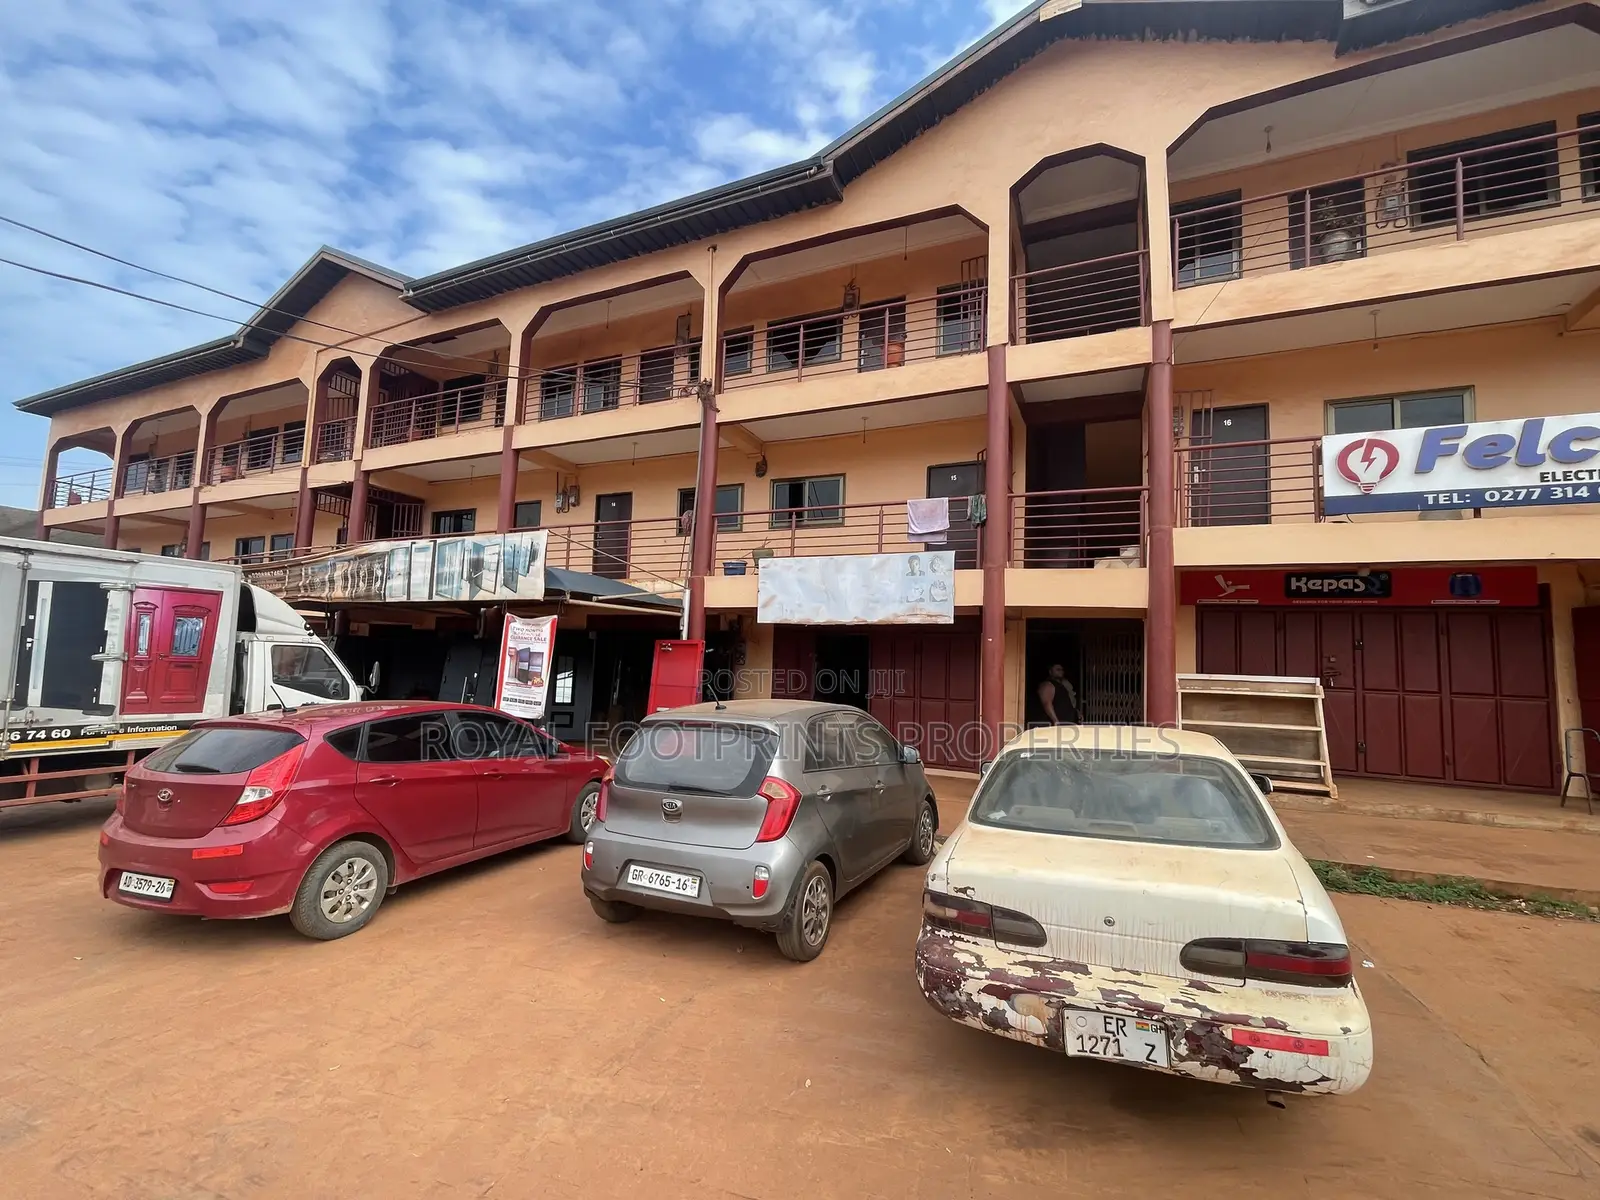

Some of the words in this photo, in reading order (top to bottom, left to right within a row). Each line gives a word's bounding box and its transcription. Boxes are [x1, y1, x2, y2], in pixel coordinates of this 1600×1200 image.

[1223, 418, 1232, 426] 16
[1540, 469, 1600, 483] ELECT
[1424, 493, 1471, 505] TEL:
[1484, 487, 1541, 502] 0277
[1550, 485, 1590, 499] 314
[1290, 576, 1366, 593] Kepas
[26, 729, 47, 740] 74
[51, 728, 71, 739] 60
[127, 724, 177, 733] Information
[665, 801, 677, 809] KIA
[631, 868, 644, 882] GR
[648, 872, 688, 891] 6765-16
[1103, 1015, 1128, 1038] ER
[1076, 1034, 1124, 1058] 1271
[1144, 1042, 1158, 1063] Z
